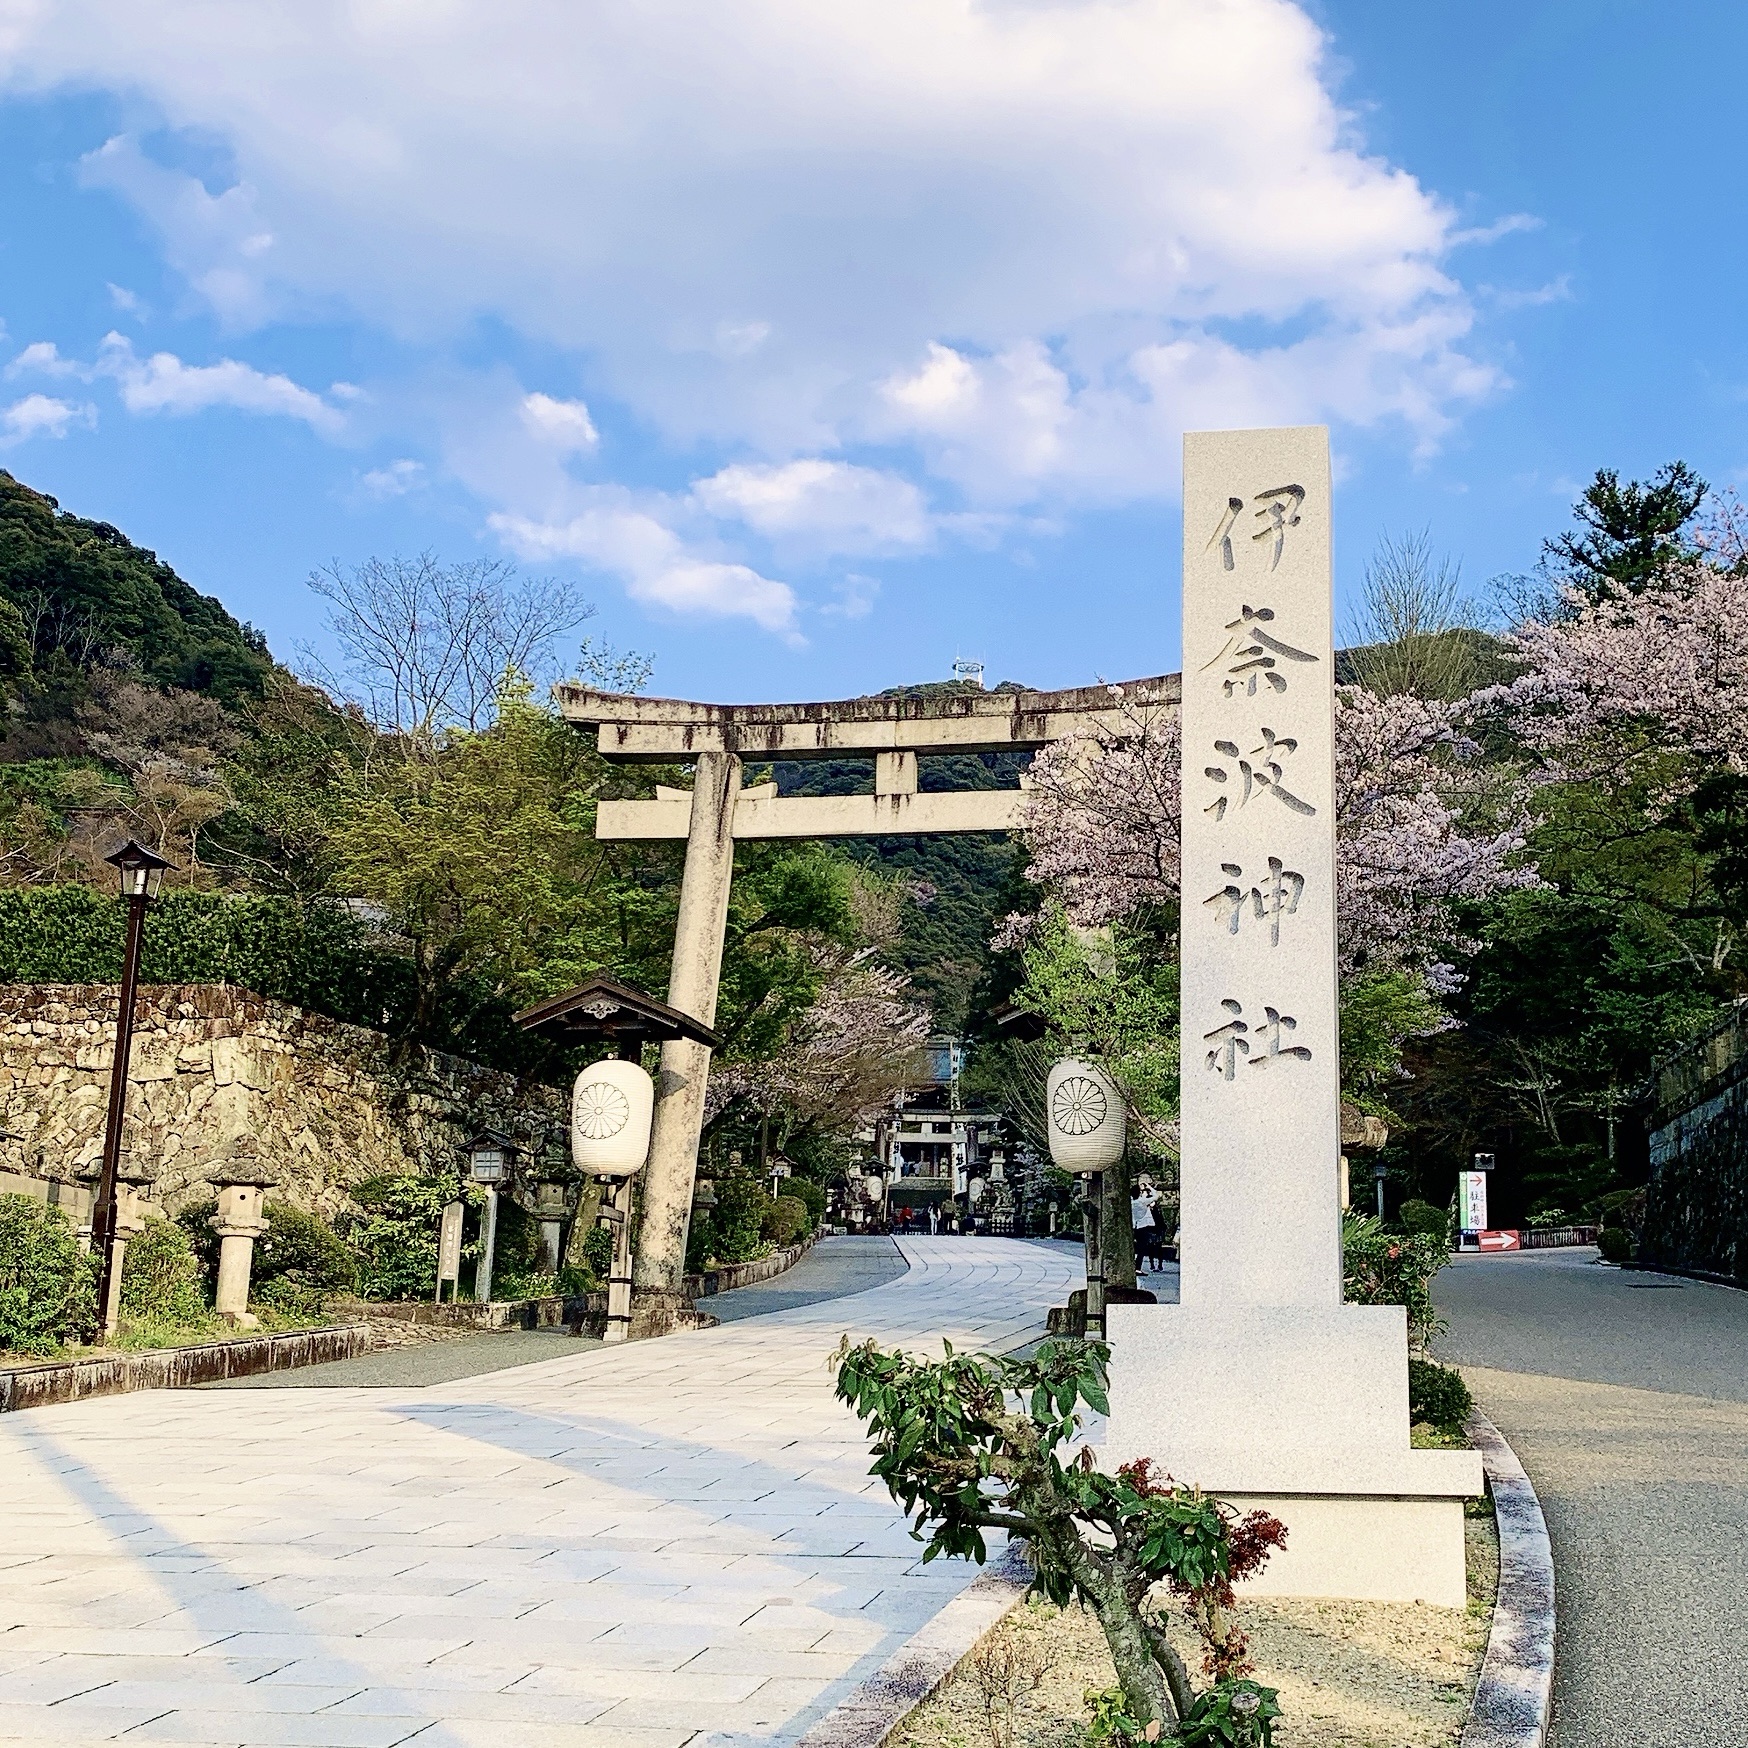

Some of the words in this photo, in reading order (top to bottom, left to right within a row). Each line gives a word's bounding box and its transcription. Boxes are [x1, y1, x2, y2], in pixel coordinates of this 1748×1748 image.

[1199, 484, 1319, 1080] 伊奈波神社
[1470, 1190, 1480, 1226] 駐車場
